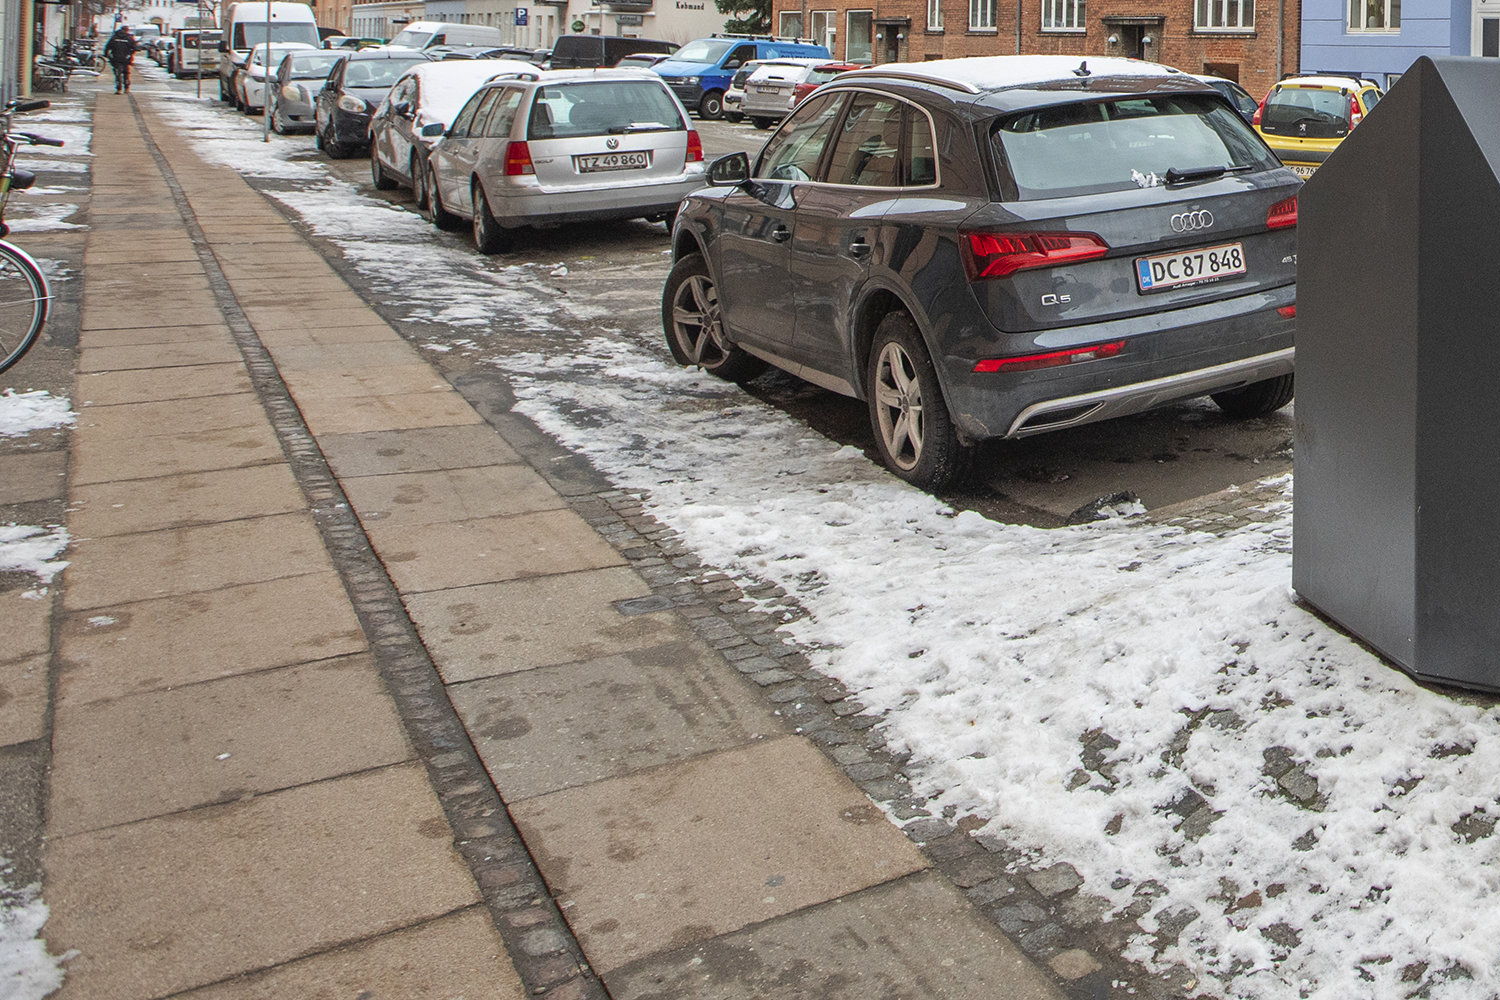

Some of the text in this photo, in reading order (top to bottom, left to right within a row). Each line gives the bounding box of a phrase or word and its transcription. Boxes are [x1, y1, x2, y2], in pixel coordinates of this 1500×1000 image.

[517, 9, 526, 19] P
[580, 152, 644, 169] TZ 49 860
[1151, 248, 1242, 283] DC 87 848
[1041, 293, 1072, 306] Q5
